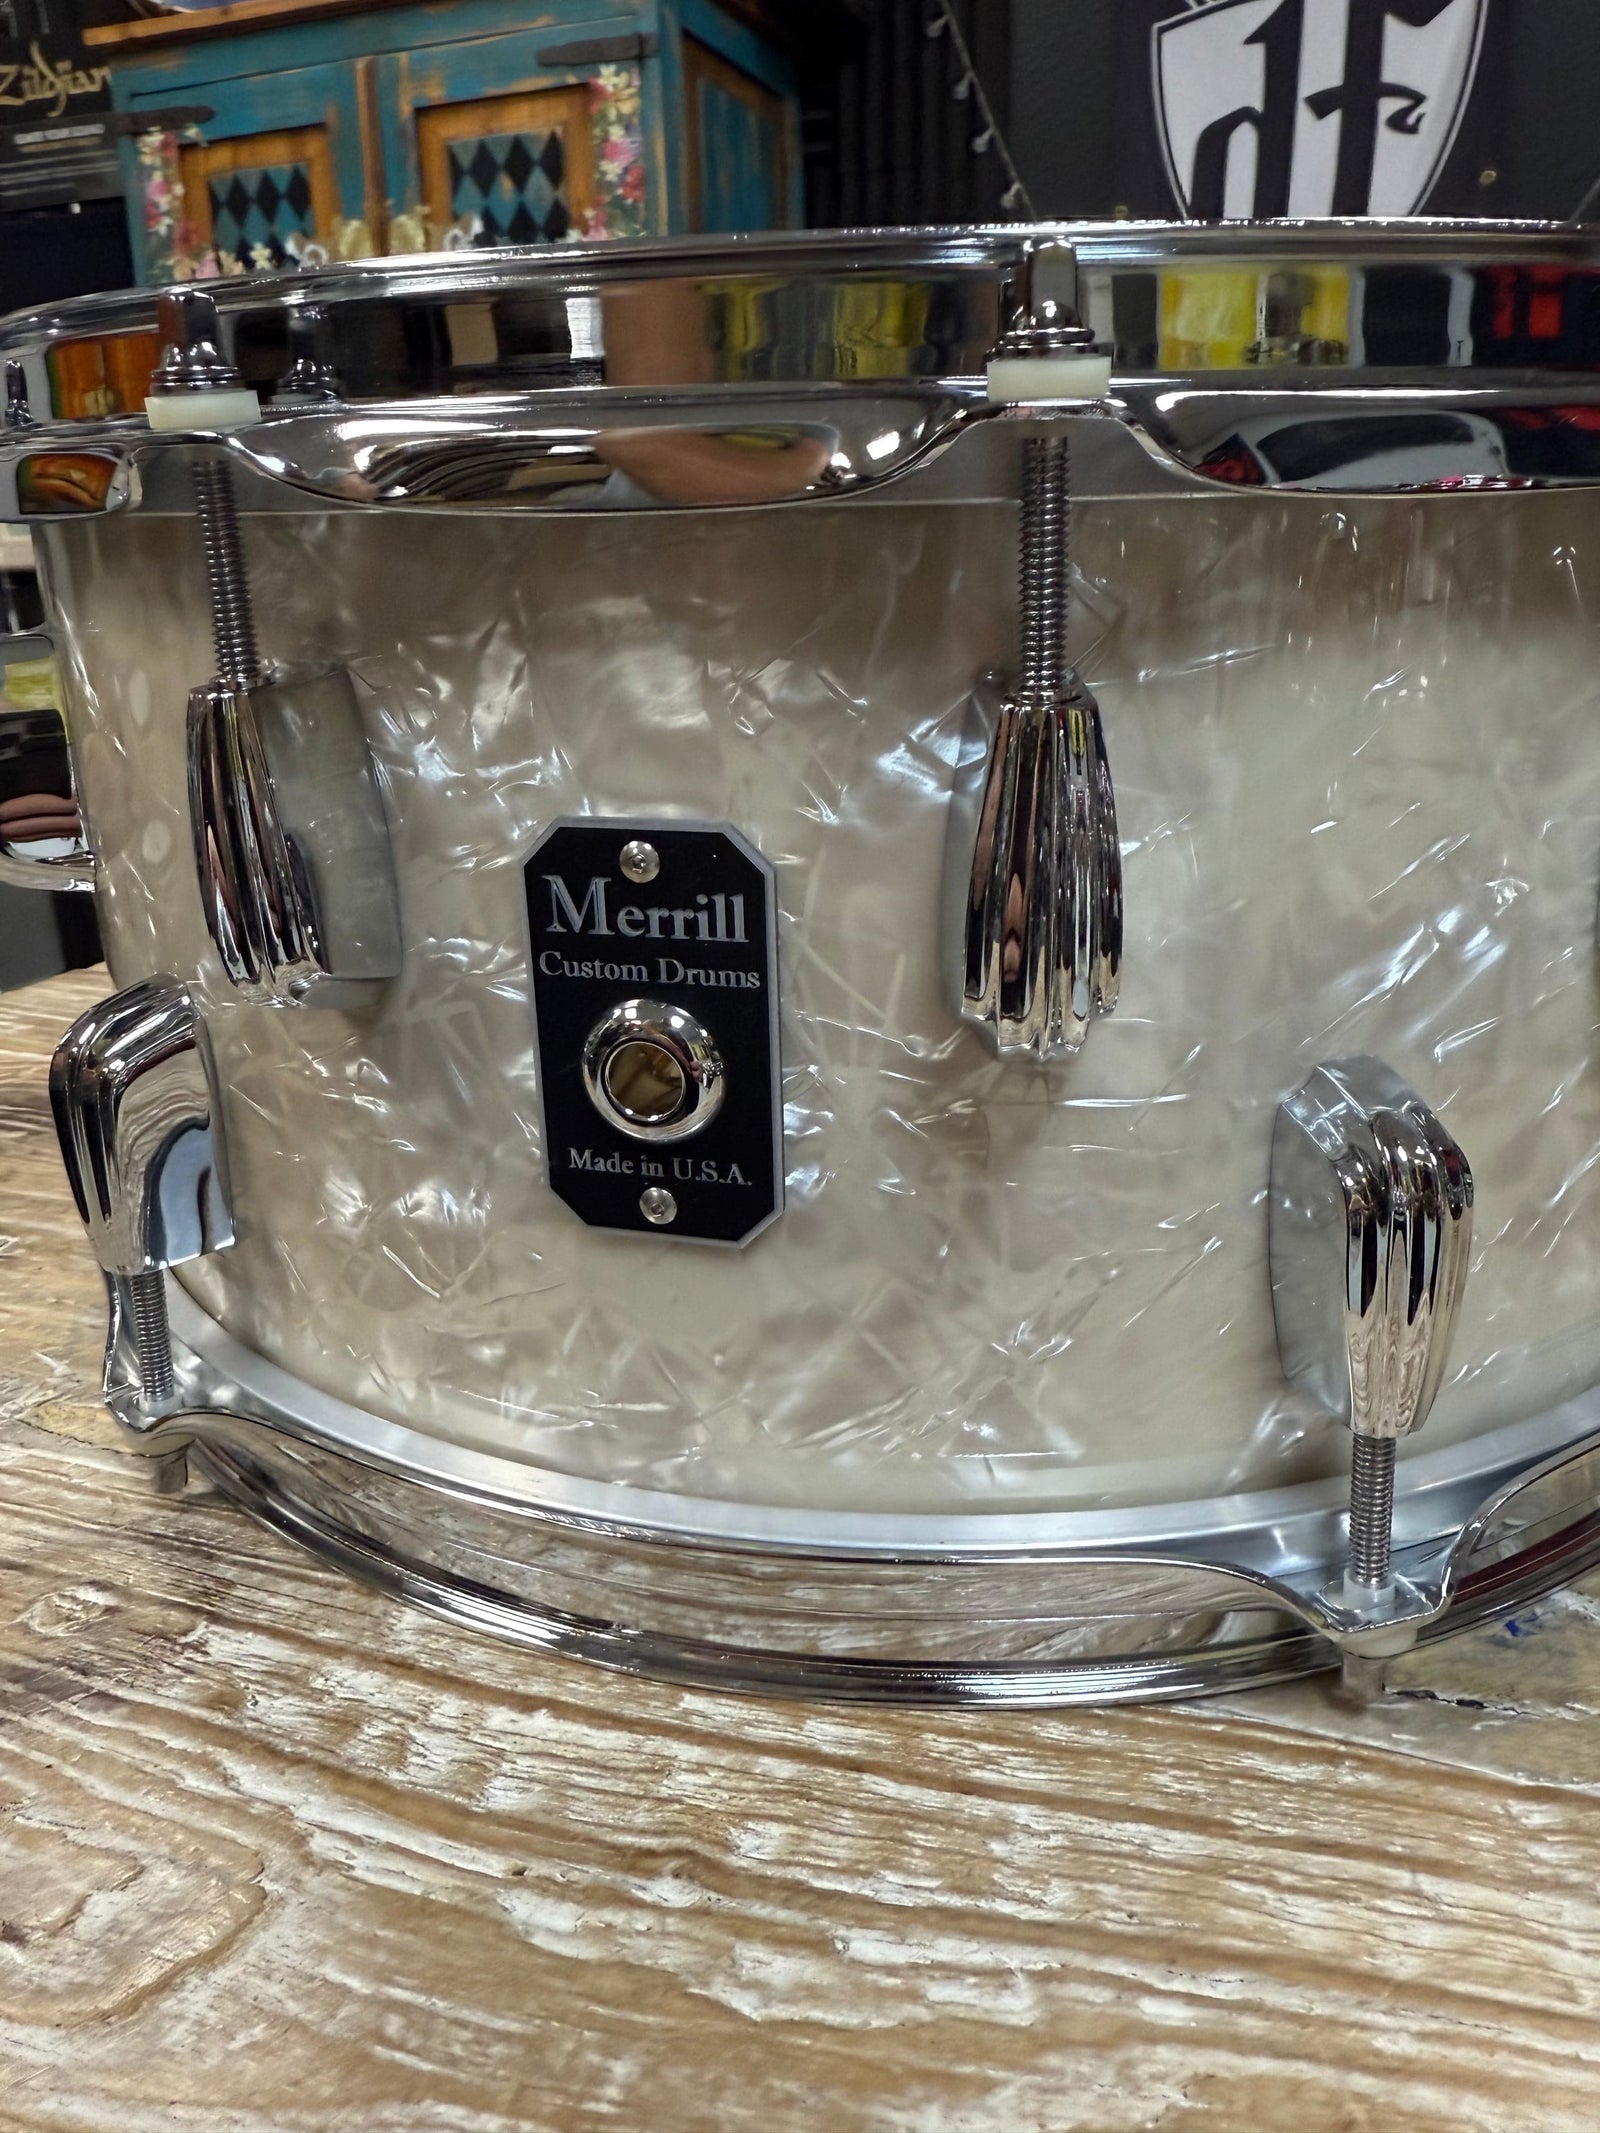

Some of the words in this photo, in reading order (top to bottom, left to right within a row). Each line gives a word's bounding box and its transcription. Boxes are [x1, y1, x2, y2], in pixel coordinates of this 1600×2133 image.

[542, 875, 749, 943] Merrill
[539, 951, 648, 983] Custom
[658, 958, 760, 988] Drums
[568, 1147, 634, 1175] Made
[640, 1154, 664, 1177] in
[673, 1157, 752, 1187] U.S.A.
